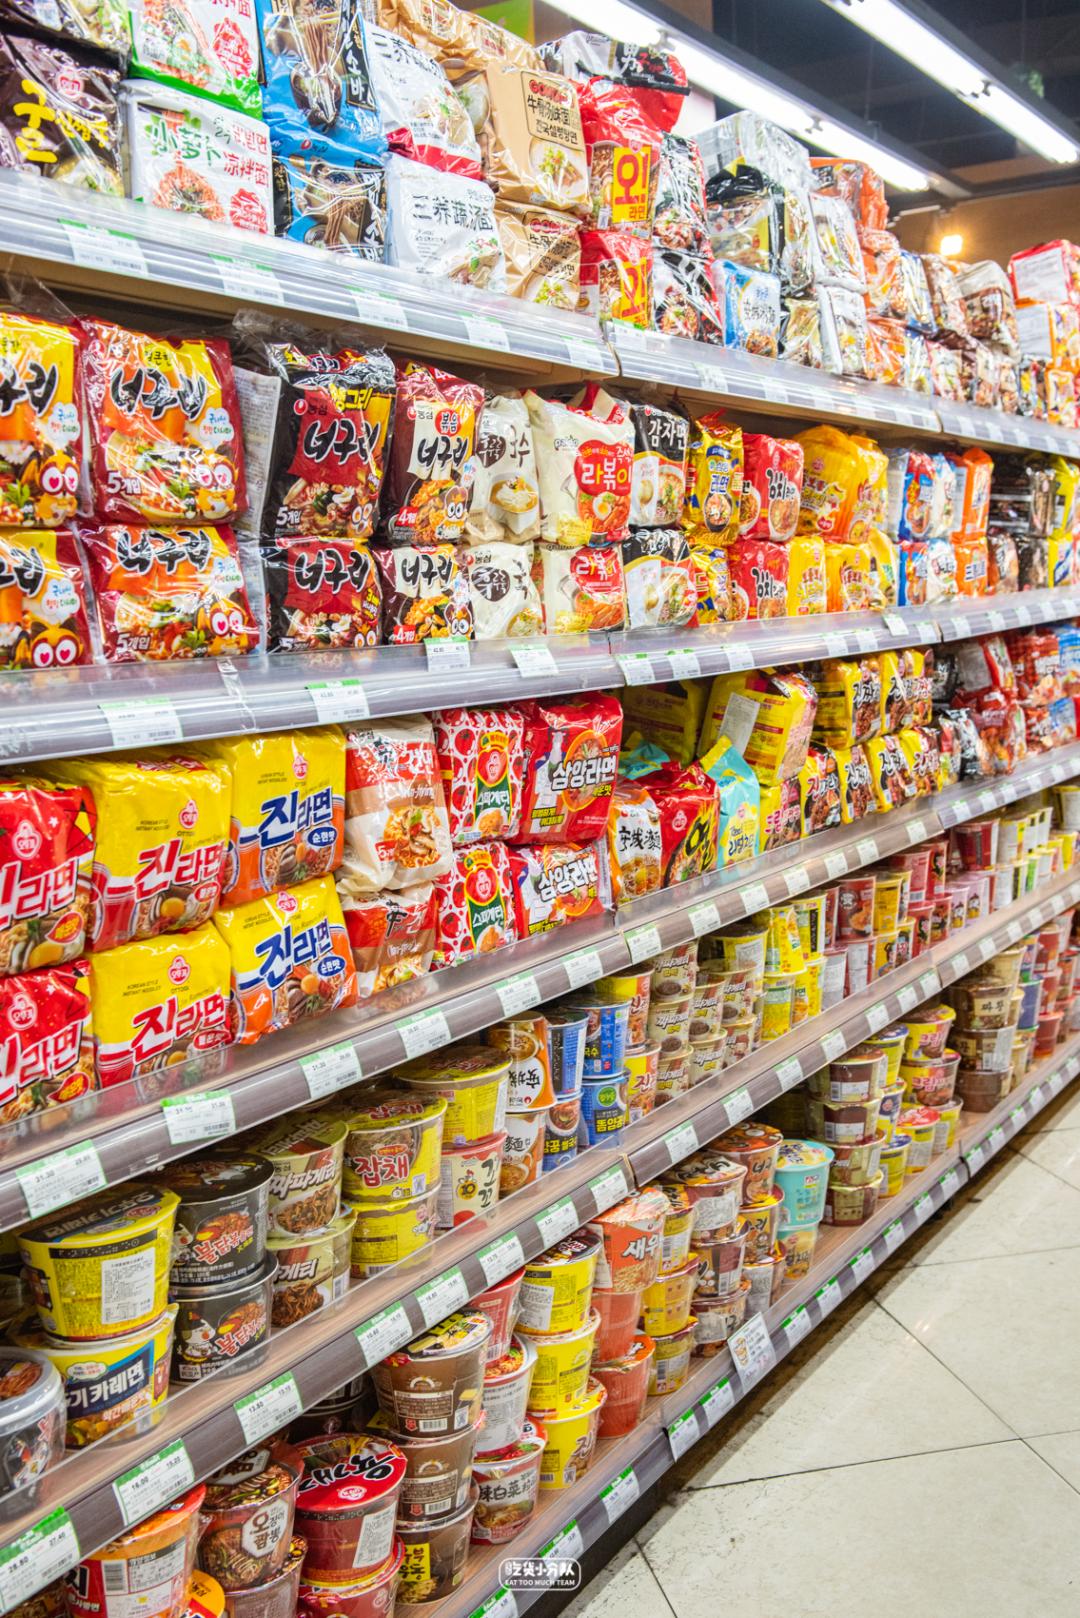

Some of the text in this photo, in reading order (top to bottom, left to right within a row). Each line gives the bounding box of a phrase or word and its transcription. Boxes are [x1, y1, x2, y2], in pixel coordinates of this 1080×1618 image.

[111, 367, 207, 420] 너구리
[303, 419, 381, 465] 너구리
[417, 437, 469, 467] 너구리
[580, 457, 633, 491] 라볶이
[294, 549, 371, 593] 너구리
[402, 554, 453, 587] 너구리
[551, 756, 617, 791] 삼양라면
[258, 787, 333, 848] 진라면
[135, 839, 225, 901] 진라면
[255, 918, 333, 988] 진라면
[131, 993, 225, 1062] 진라면
[354, 1153, 410, 1188] 잡채
